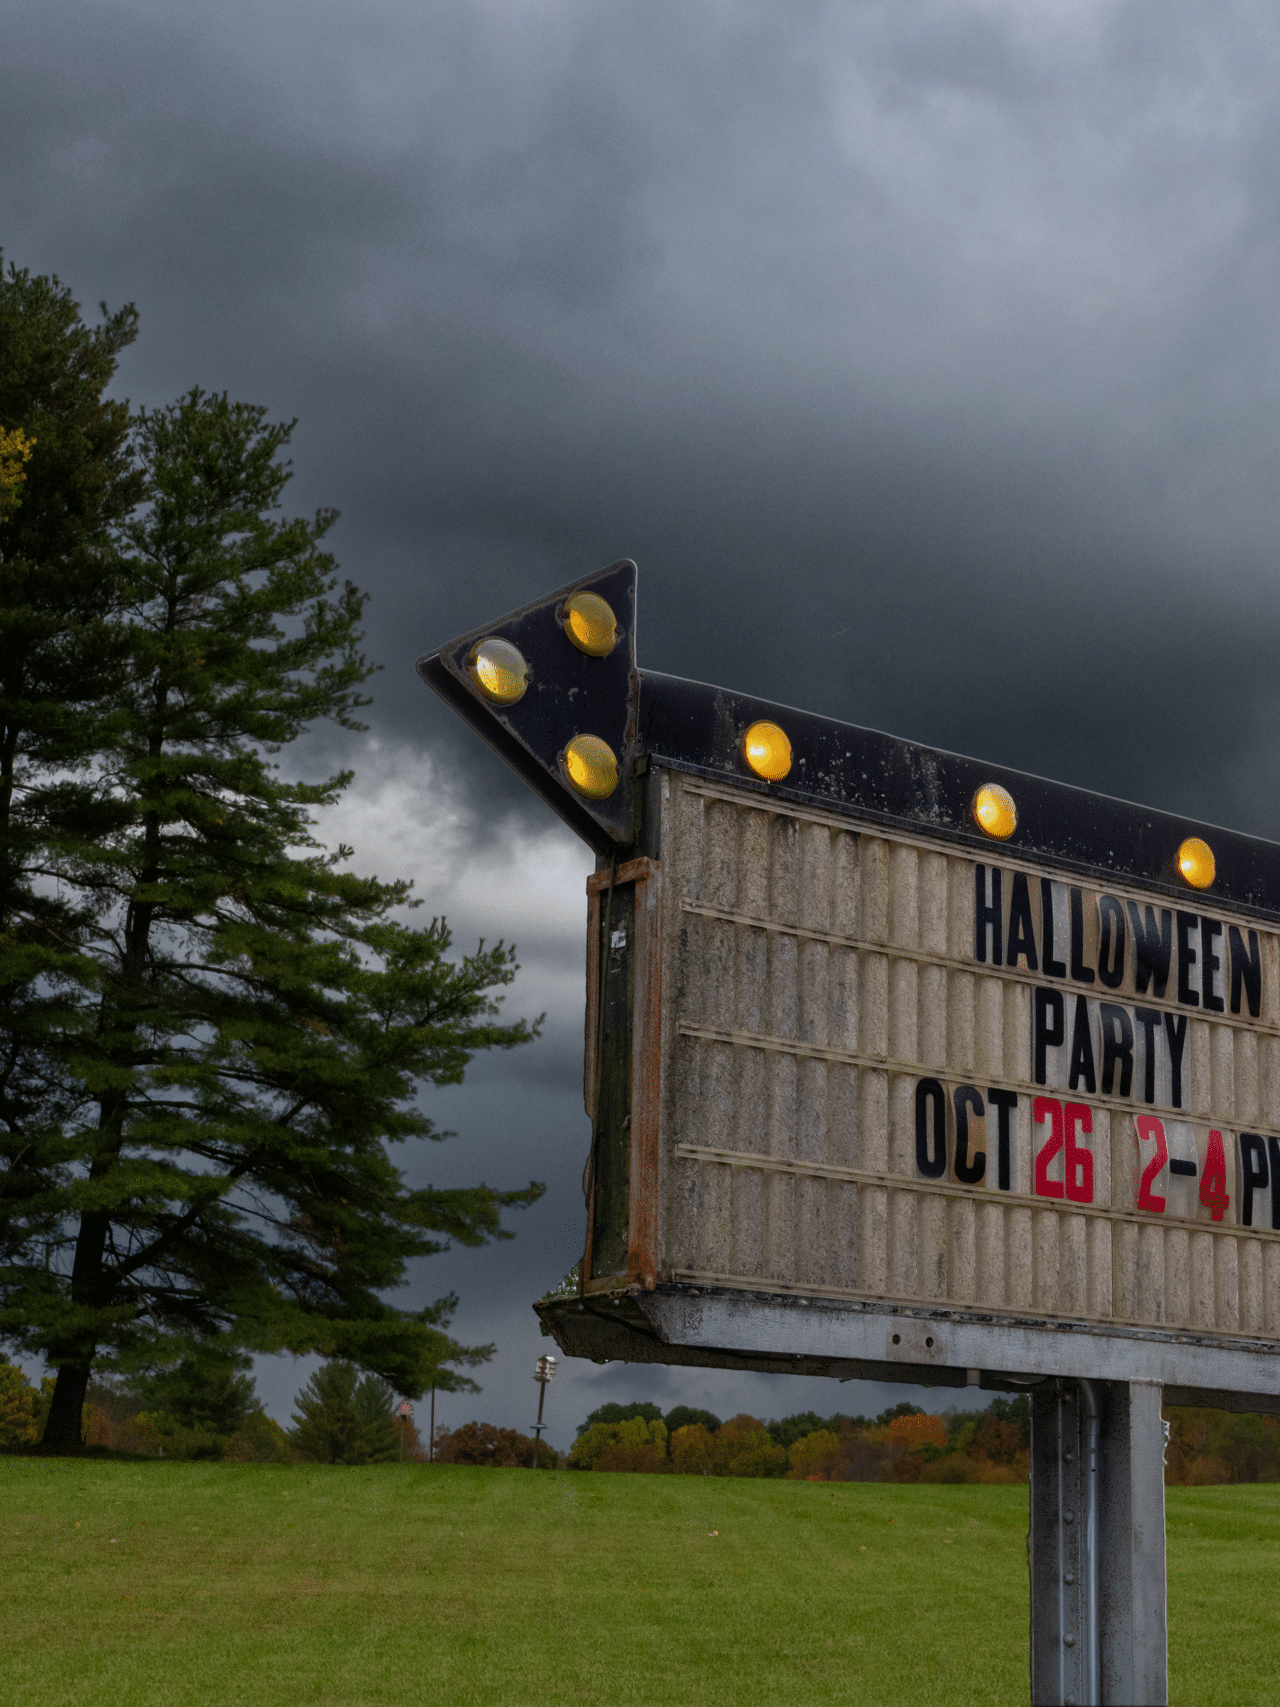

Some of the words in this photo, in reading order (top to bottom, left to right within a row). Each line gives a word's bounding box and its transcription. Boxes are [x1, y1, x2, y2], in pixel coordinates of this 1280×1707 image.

[975, 863, 1261, 1018] HALLOWEEN
[1034, 986, 1187, 1109] PARTY
[915, 1077, 1018, 1191] OCT
[1032, 1096, 1094, 1204] 26
